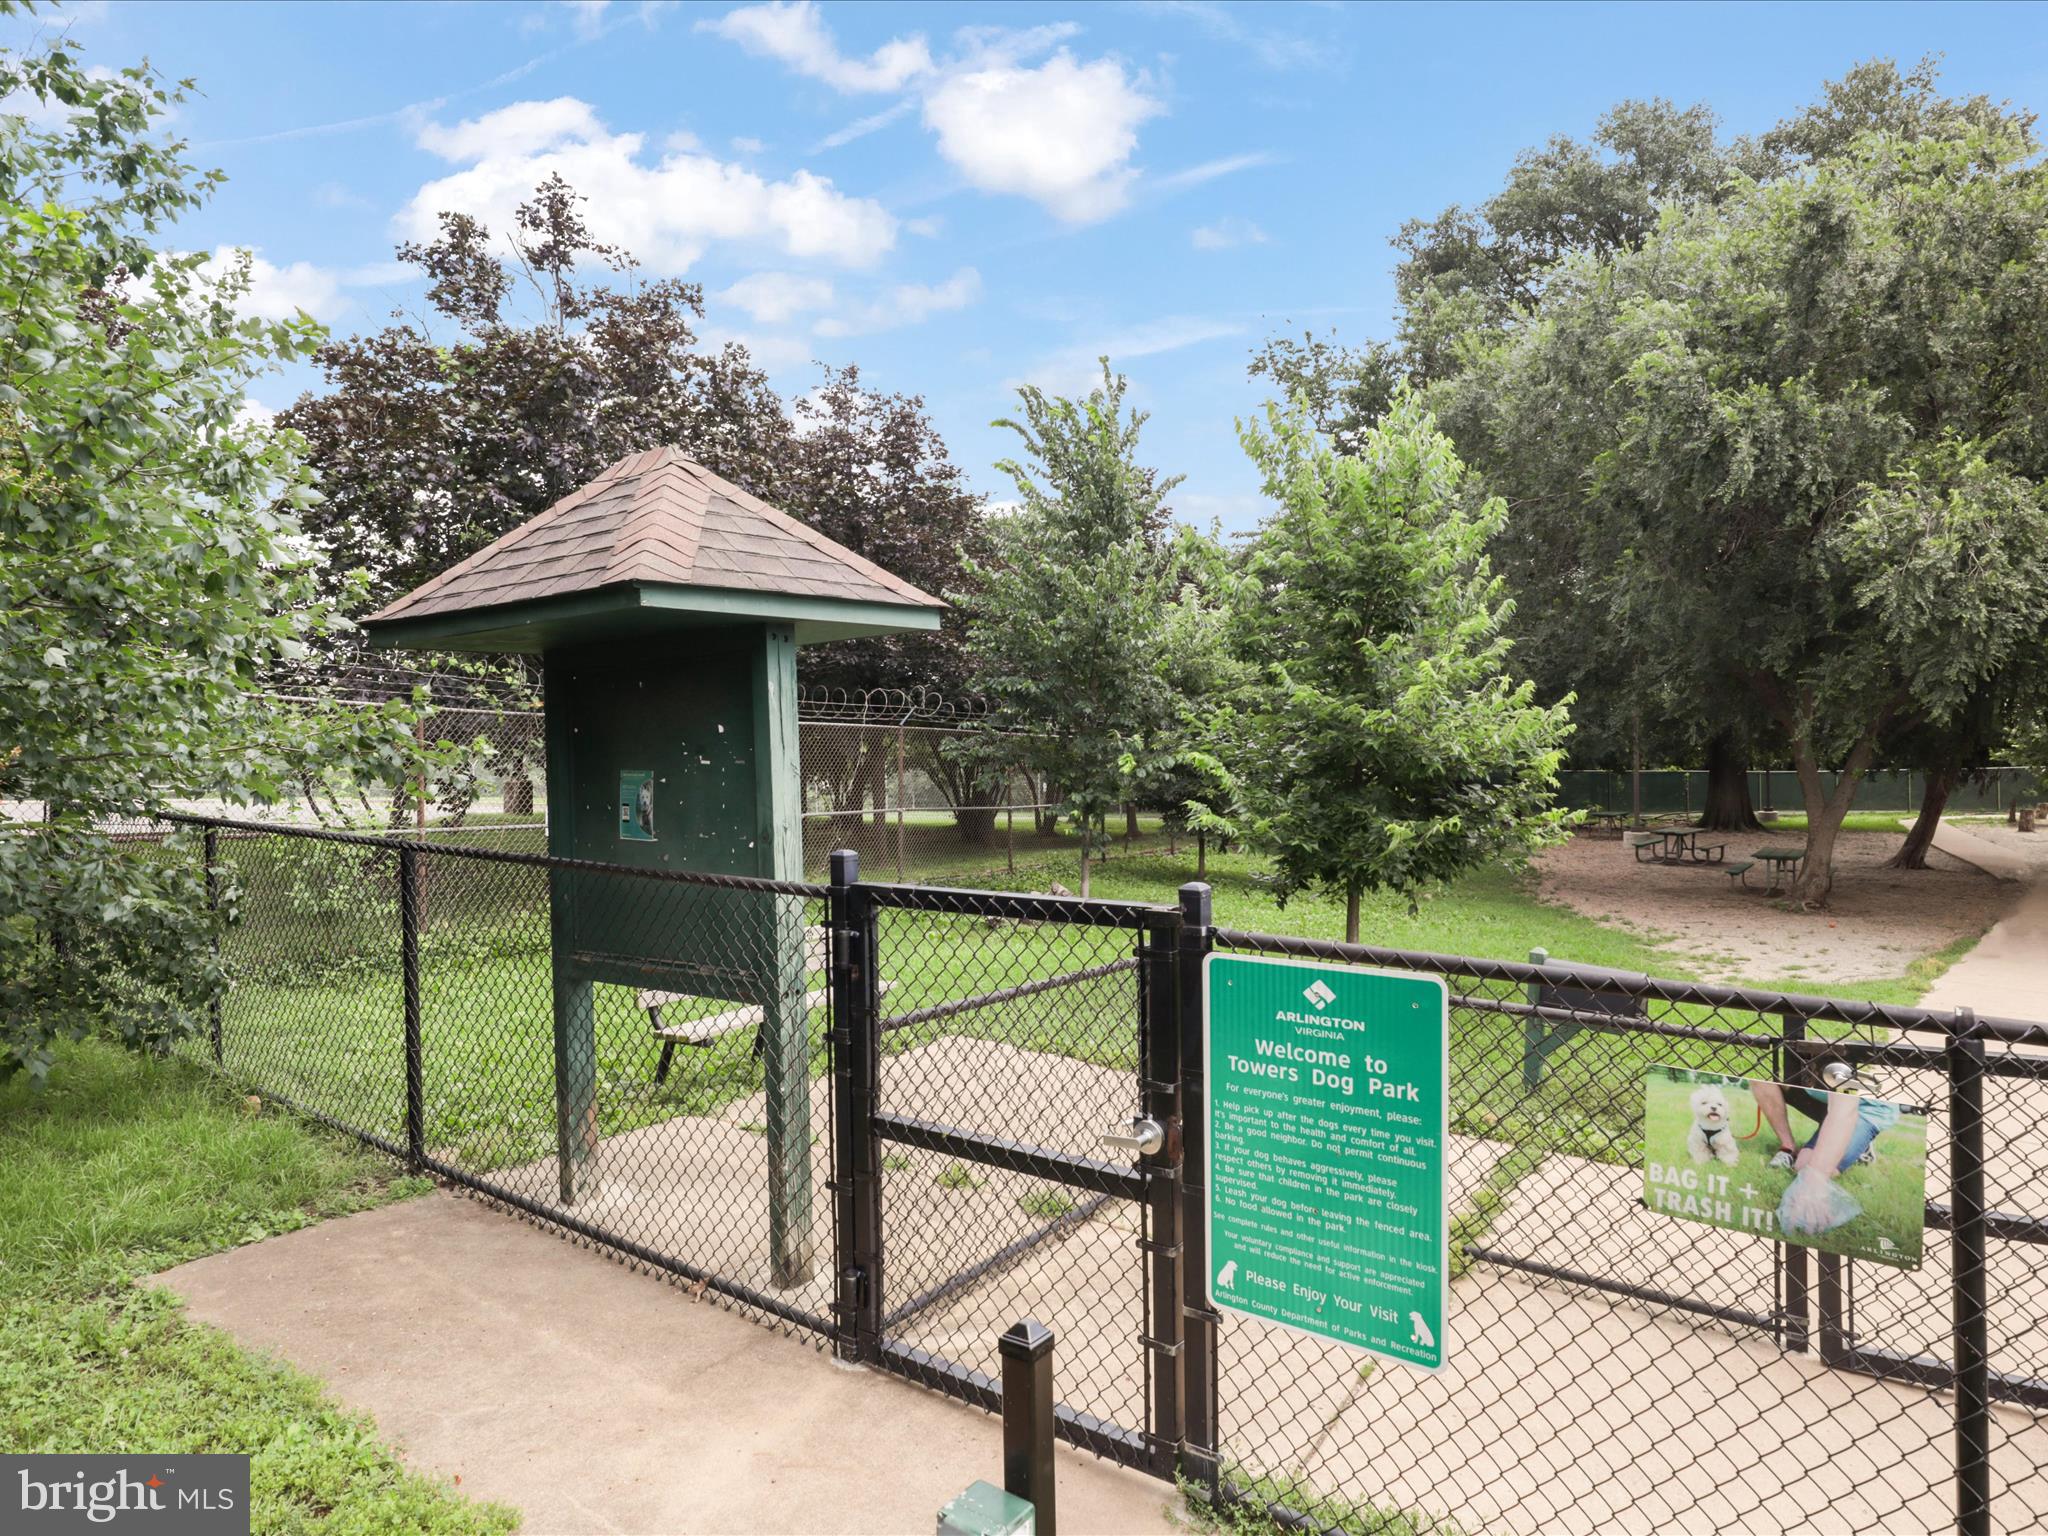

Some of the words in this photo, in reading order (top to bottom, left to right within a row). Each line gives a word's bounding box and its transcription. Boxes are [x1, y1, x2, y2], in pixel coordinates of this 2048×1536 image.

[1276, 1010, 1365, 1032] ARLINGTON
[1295, 1026, 1345, 1040] VIRGINIA
[1255, 1039, 1351, 1069] Welcome
[1364, 1055, 1388, 1074] to
[1228, 1055, 1298, 1082] Towers
[1312, 1068, 1354, 1095] Dog
[1369, 1077, 1419, 1102] Park
[1223, 1101, 1240, 1111] Help
[1244, 1105, 1259, 1114] pick
[1263, 1109, 1273, 1118] up
[1277, 1111, 1296, 1121] after
[1300, 1115, 1314, 1125] the
[1318, 1118, 1339, 1130] dogs
[1342, 1124, 1367, 1137] every
[1370, 1128, 1391, 1139] time
[1394, 1134, 1411, 1143] you
[1415, 1137, 1436, 1148] visit.
[1226, 1082, 1239, 1092] For
[1243, 1087, 1289, 1101] everyone's
[1293, 1096, 1325, 1108] greater
[1330, 1102, 1382, 1119] enjoyment,
[1386, 1112, 1421, 1125] please:
[1215, 1110, 1225, 1118] It's
[1229, 1113, 1267, 1127] important
[1271, 1120, 1280, 1129] to
[1283, 1123, 1296, 1133] the
[1300, 1126, 1326, 1138] health
[1330, 1133, 1347, 1142] and
[1350, 1137, 1385, 1150] comfort
[1389, 1143, 1399, 1152] of
[1215, 1131, 1245, 1145] barking.
[1224, 1122, 1234, 1131] Be
[1246, 1128, 1267, 1137] good
[1270, 1132, 1307, 1145] neighbor.
[1311, 1139, 1323, 1149] Do
[1326, 1143, 1341, 1155] not
[1344, 1147, 1373, 1159] permit
[1377, 1154, 1427, 1170] continuous
[1215, 1153, 1243, 1164] respect
[1247, 1160, 1272, 1171] others
[1275, 1164, 1285, 1176] by
[1289, 1169, 1328, 1185] removing
[1341, 1179, 1396, 1200] immediately.
[1215, 1174, 1258, 1190] supervised.
[1234, 1146, 1250, 1155] your
[1254, 1150, 1269, 1161] dog
[1273, 1153, 1306, 1168] behaves
[1310, 1163, 1364, 1181] aggressively,
[1368, 1174, 1397, 1187] please
[1649, 1162, 1698, 1190] BAG
[1707, 1173, 1729, 1196] IT
[1740, 1183, 1759, 1199] +
[1225, 1165, 1235, 1174] Be
[1238, 1169, 1255, 1178] sure
[1258, 1172, 1274, 1183] that
[1278, 1177, 1310, 1191] children
[1326, 1187, 1340, 1198] the
[1344, 1192, 1363, 1202] park
[1367, 1198, 1382, 1207] are
[1386, 1201, 1418, 1217] closely
[1654, 1188, 1731, 1222] TRASH
[1742, 1206, 1773, 1232] IT!
[1225, 1186, 1247, 1197] Leash
[1251, 1193, 1267, 1202] your
[1271, 1197, 1287, 1209] dog
[1290, 1201, 1319, 1215] before
[1321, 1208, 1352, 1225] leaving
[1356, 1216, 1370, 1227] the
[1374, 1220, 1405, 1235] fenced
[1409, 1230, 1432, 1241] area.
[1225, 1197, 1236, 1206] No
[1239, 1200, 1258, 1211] food
[1261, 1206, 1293, 1220] allowed
[1296, 1213, 1304, 1222] in
[1308, 1216, 1321, 1227] the
[1325, 1221, 1347, 1232] park.
[1214, 1211, 1225, 1220] See
[1228, 1216, 1258, 1228] complete
[1261, 1224, 1277, 1233] rules
[1280, 1229, 1293, 1238] and
[1296, 1233, 1315, 1243] other
[1318, 1239, 1340, 1249] useful
[1343, 1244, 1386, 1261] information
[1400, 1258, 1413, 1267] the
[1224, 1230, 1238, 1239] Your
[1241, 1236, 1272, 1249] voluntary
[1275, 1244, 1313, 1259] compliance
[1316, 1254, 1330, 1264] and
[1333, 1259, 1361, 1271] support
[1364, 1268, 1377, 1276] are
[1380, 1271, 1425, 1289] appreciated
[1860, 1246, 1918, 1262] ARLINGTON
[1234, 1243, 1247, 1251] and
[1249, 1247, 1261, 1255] will
[1264, 1251, 1287, 1262] reduce
[1289, 1257, 1301, 1265] the
[1304, 1261, 1322, 1271] need
[1325, 1265, 1335, 1274] for
[1339, 1271, 1360, 1281] active
[1246, 1270, 1286, 1292] Please
[1293, 1283, 1327, 1305] Enjoy
[1333, 1294, 1362, 1313] Your
[1370, 1305, 1398, 1324] Visit
[1215, 1289, 1248, 1305] Arlington
[1251, 1300, 1278, 1315] County
[1281, 1308, 1328, 1329] Department
[1331, 1324, 1340, 1332] of
[1344, 1327, 1367, 1340] Parks
[1371, 1336, 1387, 1347] and
[1390, 1340, 1437, 1361] Recreation
